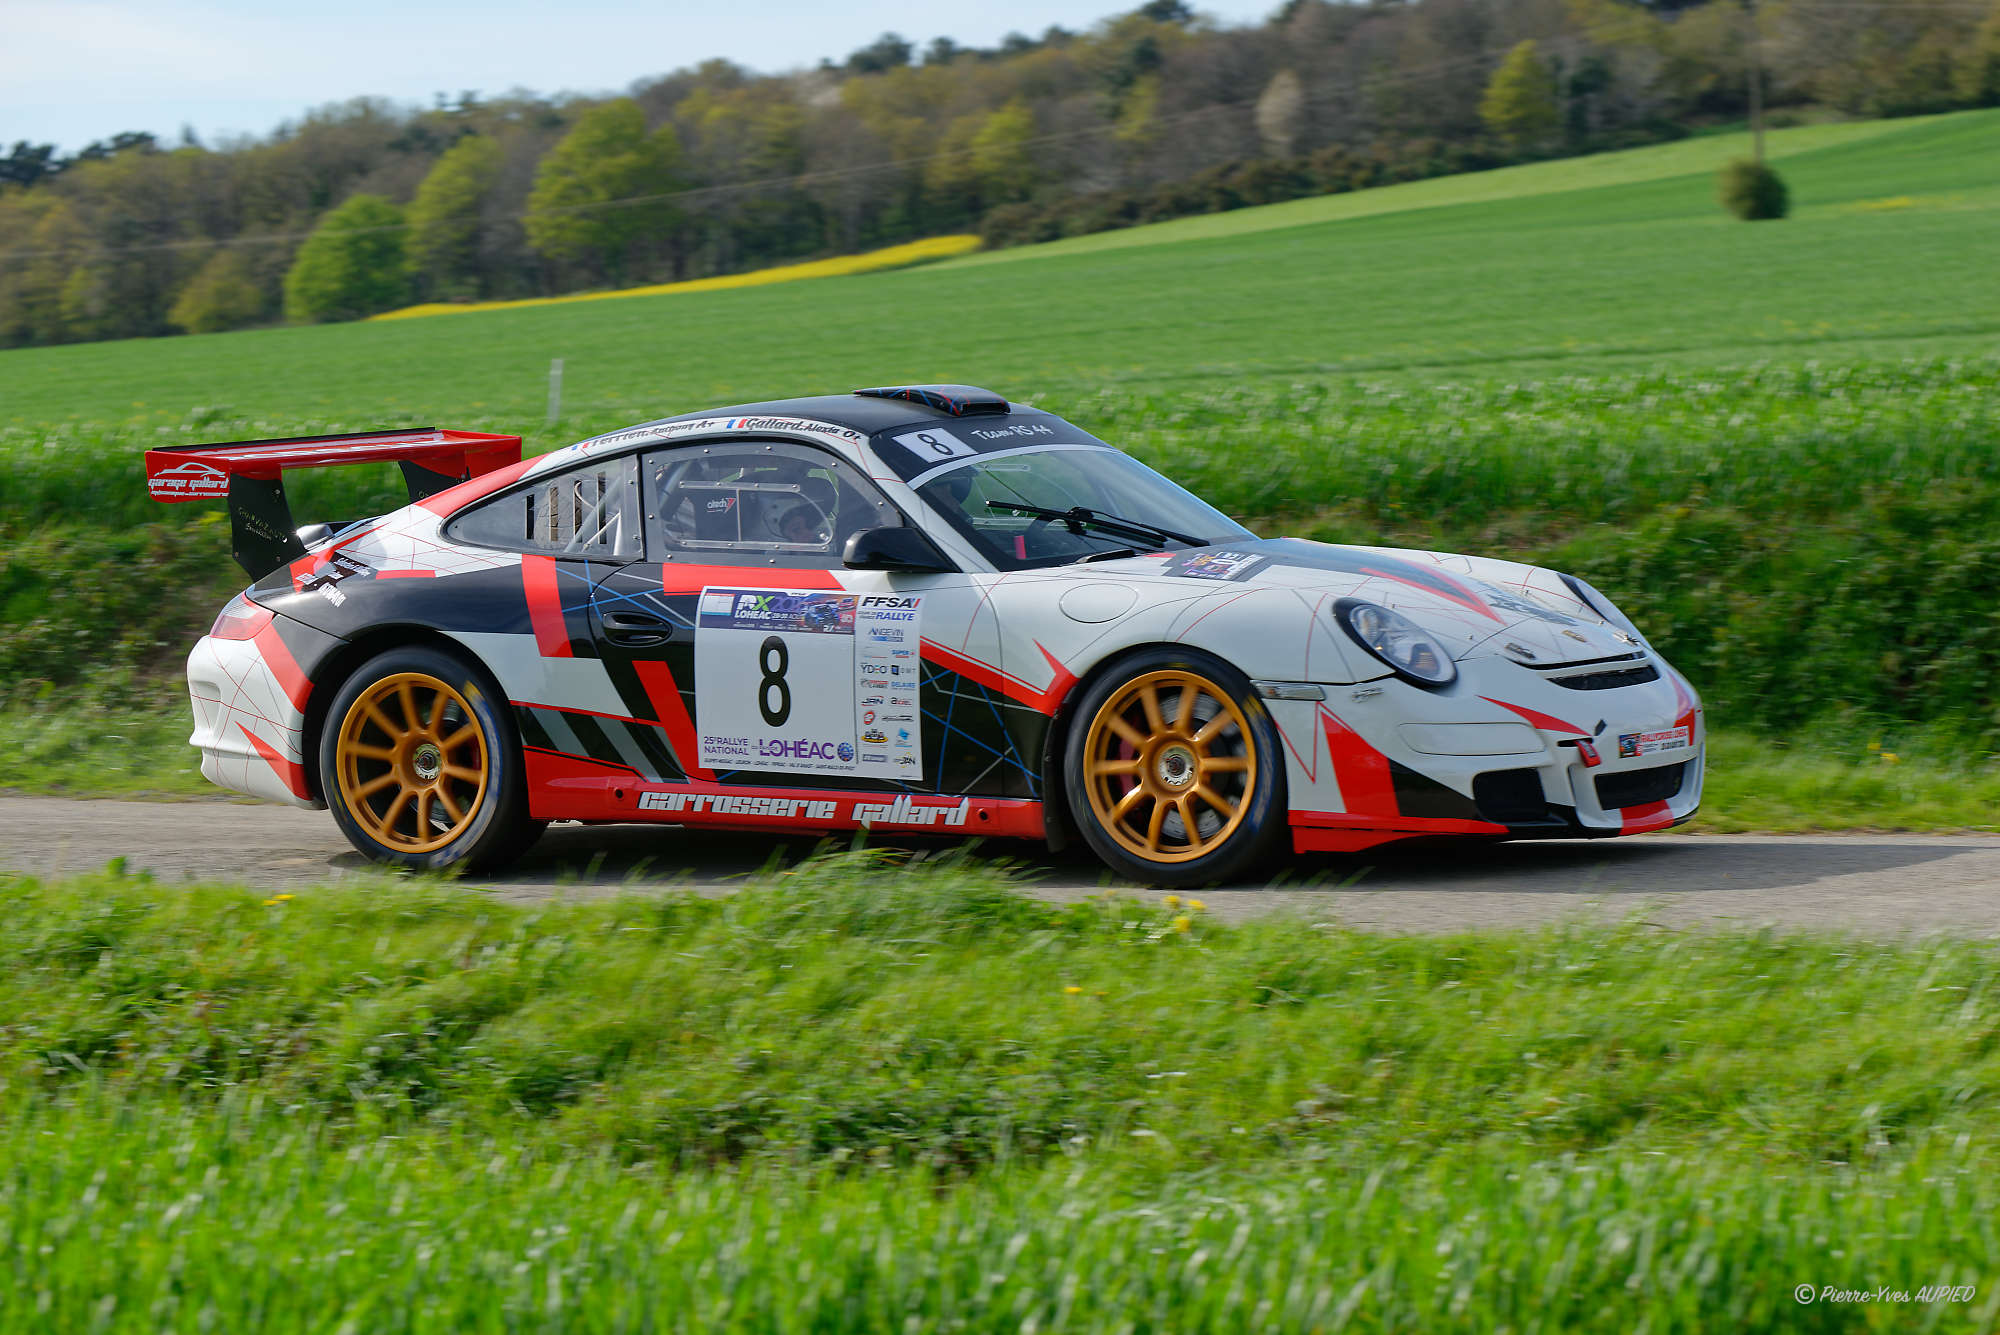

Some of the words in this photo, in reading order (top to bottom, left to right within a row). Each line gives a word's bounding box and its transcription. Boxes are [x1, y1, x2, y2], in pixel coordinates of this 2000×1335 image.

[917, 433, 954, 456] 8
[147, 478, 188, 491] garage
[188, 476, 229, 491] gallard
[862, 596, 913, 609] FFSA
[875, 611, 915, 621] RALLYE
[759, 635, 791, 727] 8
[715, 736, 749, 746] RALLYE
[703, 745, 750, 756] NATIONAL
[759, 738, 835, 760] LOHÉAC
[638, 791, 837, 819] carrosserie
[851, 794, 969, 830] gallard
